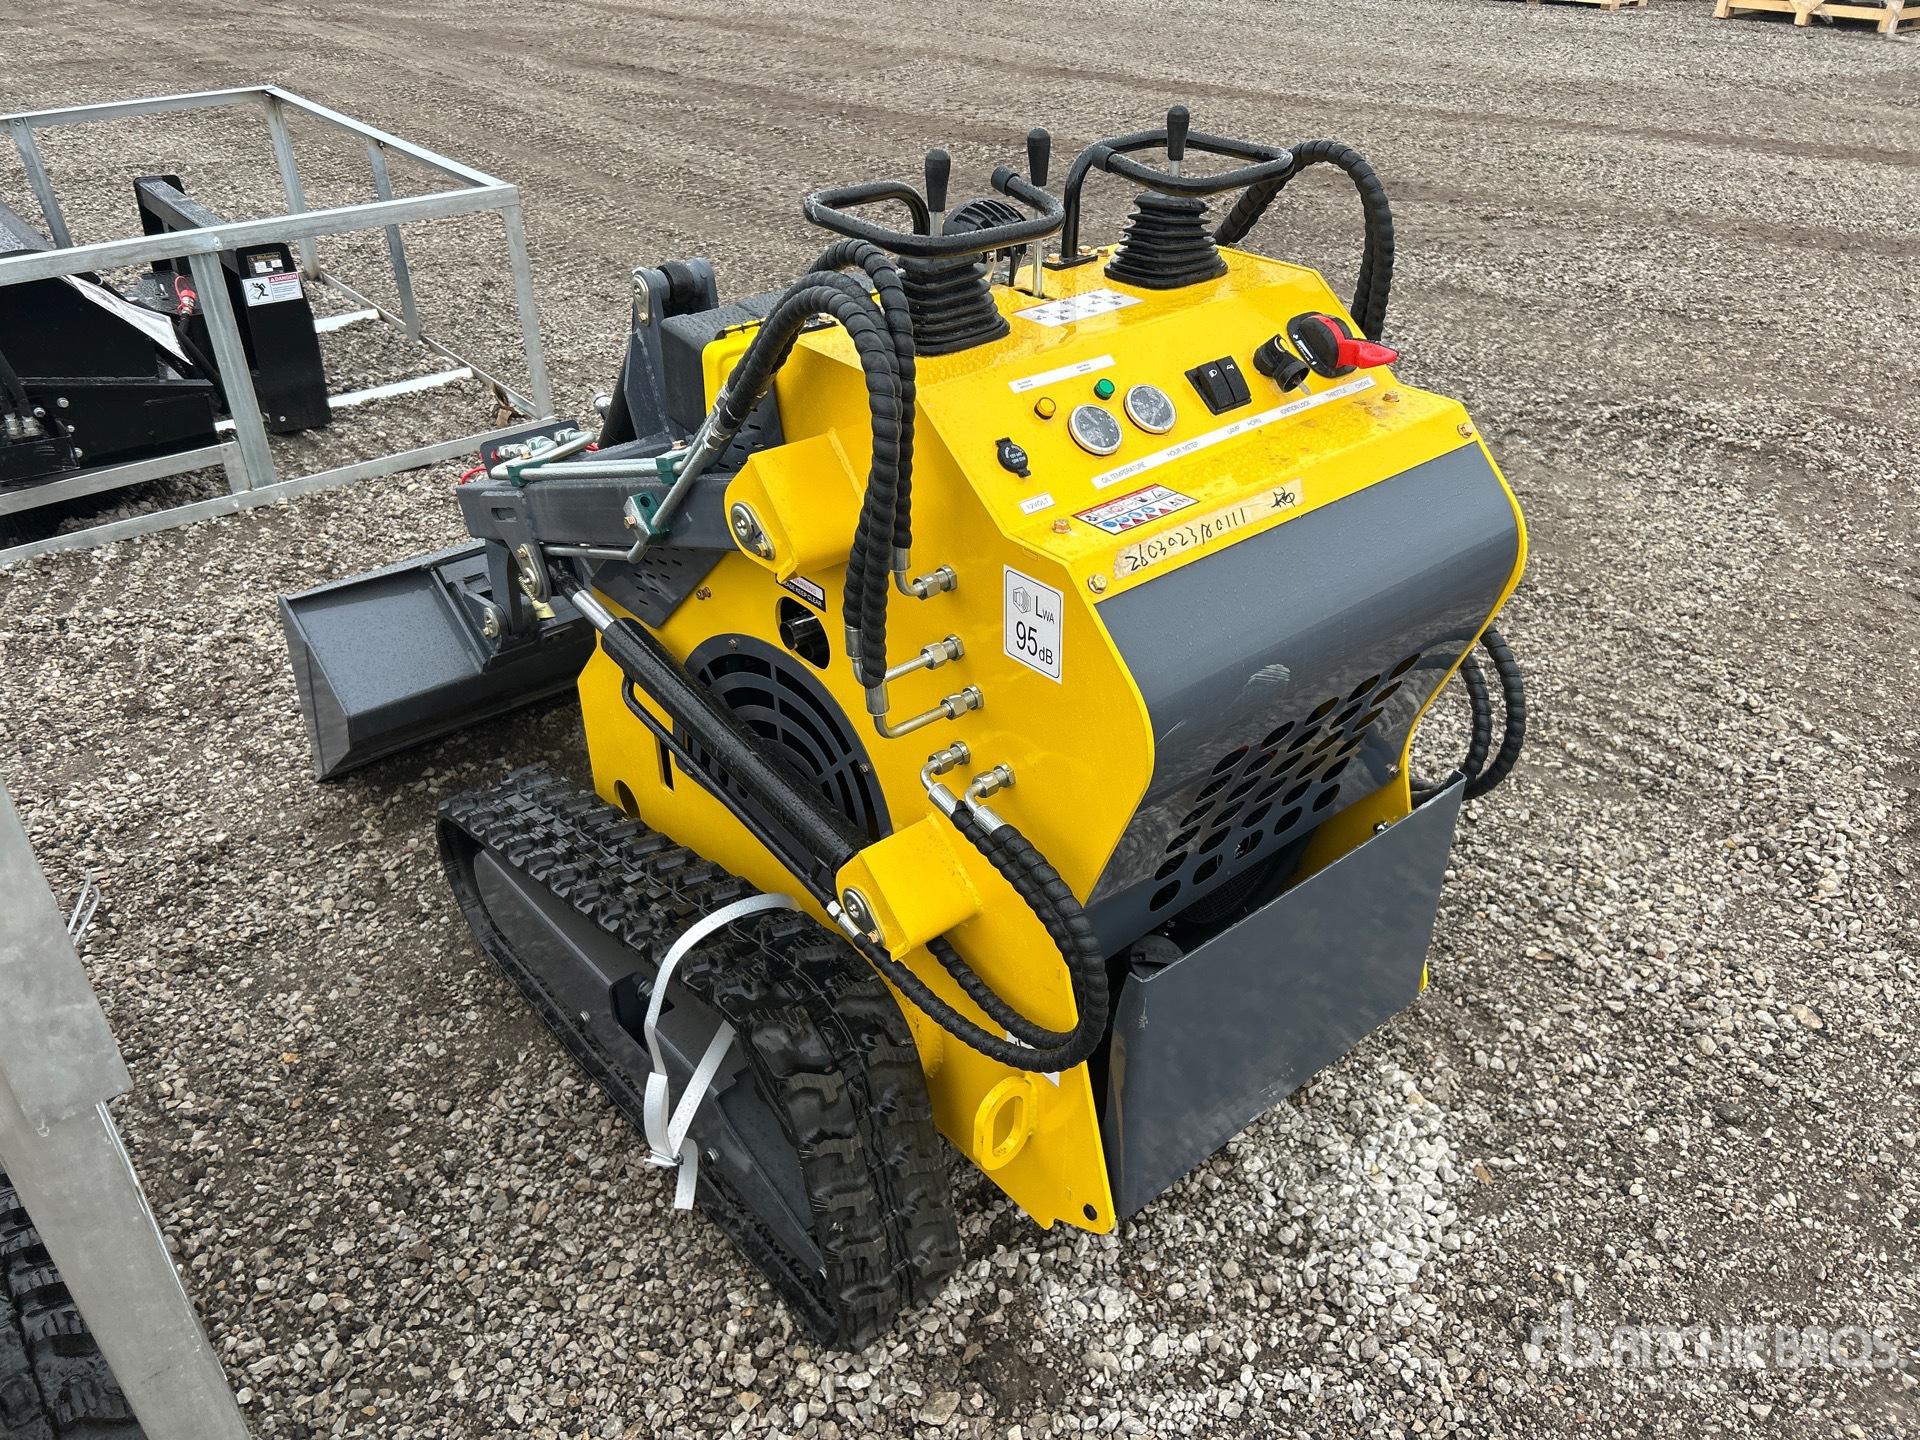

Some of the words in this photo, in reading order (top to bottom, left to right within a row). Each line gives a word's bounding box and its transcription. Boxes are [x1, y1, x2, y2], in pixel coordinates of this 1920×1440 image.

[274, 274, 297, 282] DANGER
[1354, 379, 1371, 390] CHOKE
[1325, 387, 1348, 399] THROTTLE
[1280, 403, 1301, 415] IGNITION
[1246, 418, 1262, 427] HORN
[1226, 425, 1240, 435] LAMP
[1166, 447, 1181, 458] HOUR
[1183, 441, 1199, 452] METER
[1110, 461, 1147, 481] TEMPERATURE
